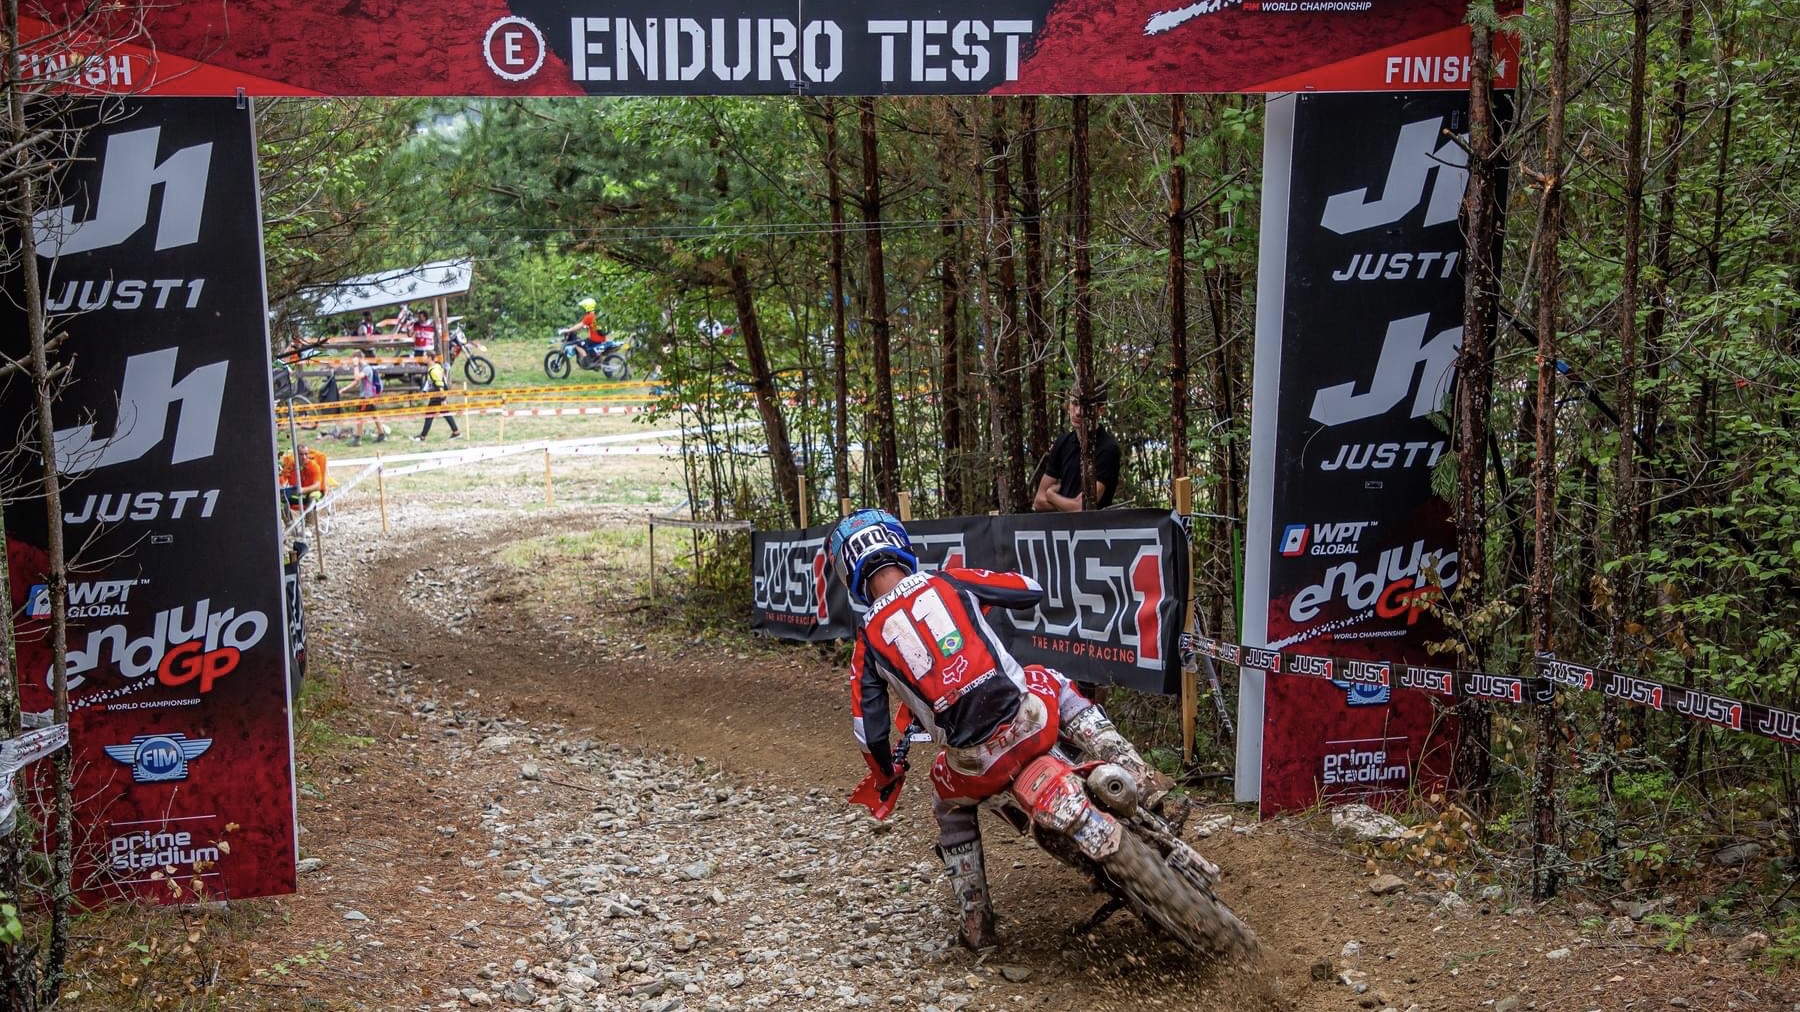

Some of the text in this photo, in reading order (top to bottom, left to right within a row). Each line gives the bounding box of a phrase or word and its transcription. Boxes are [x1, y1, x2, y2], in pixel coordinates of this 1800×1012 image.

[1262, 2, 1297, 11] WORLD
[1300, 2, 1372, 11] CHAMPIONSHIP
[570, 17, 1033, 82] ENDURO TEST
[1332, 251, 1459, 281] JUST1
[47, 278, 205, 311] JUST1
[1320, 441, 1445, 471] JUST1
[64, 489, 220, 524] JUST1
[1313, 523, 1369, 543] WPT
[1310, 544, 1360, 556] GLOBAL
[67, 579, 137, 605] WPT
[754, 536, 830, 626] JUST1
[67, 604, 129, 618] GLOBAL
[1006, 528, 1165, 671] JUST1
[45, 598, 268, 693] enduro
[881, 588, 964, 681] 11
[1333, 633, 1358, 641] WORLD
[1032, 635, 1135, 664] THE ART OF RACING
[157, 641, 241, 694] GP
[1245, 648, 1281, 673] JUST1
[1290, 654, 1333, 680] JUST1
[1343, 660, 1390, 687] JUST1
[1401, 666, 1453, 695] JUST1
[1464, 673, 1522, 703] JUST1
[107, 702, 138, 711] WORLD
[139, 698, 201, 709] CHAMPIONSHIP
[1543, 661, 1593, 690] JUST1
[1605, 674, 1662, 711] JUST1
[1677, 690, 1742, 731] JUST1
[142, 749, 177, 768] FIM
[1323, 749, 1386, 773] prime
[1323, 765, 1406, 785] stadium
[111, 830, 191, 857] prime
[111, 845, 219, 869] stadium
